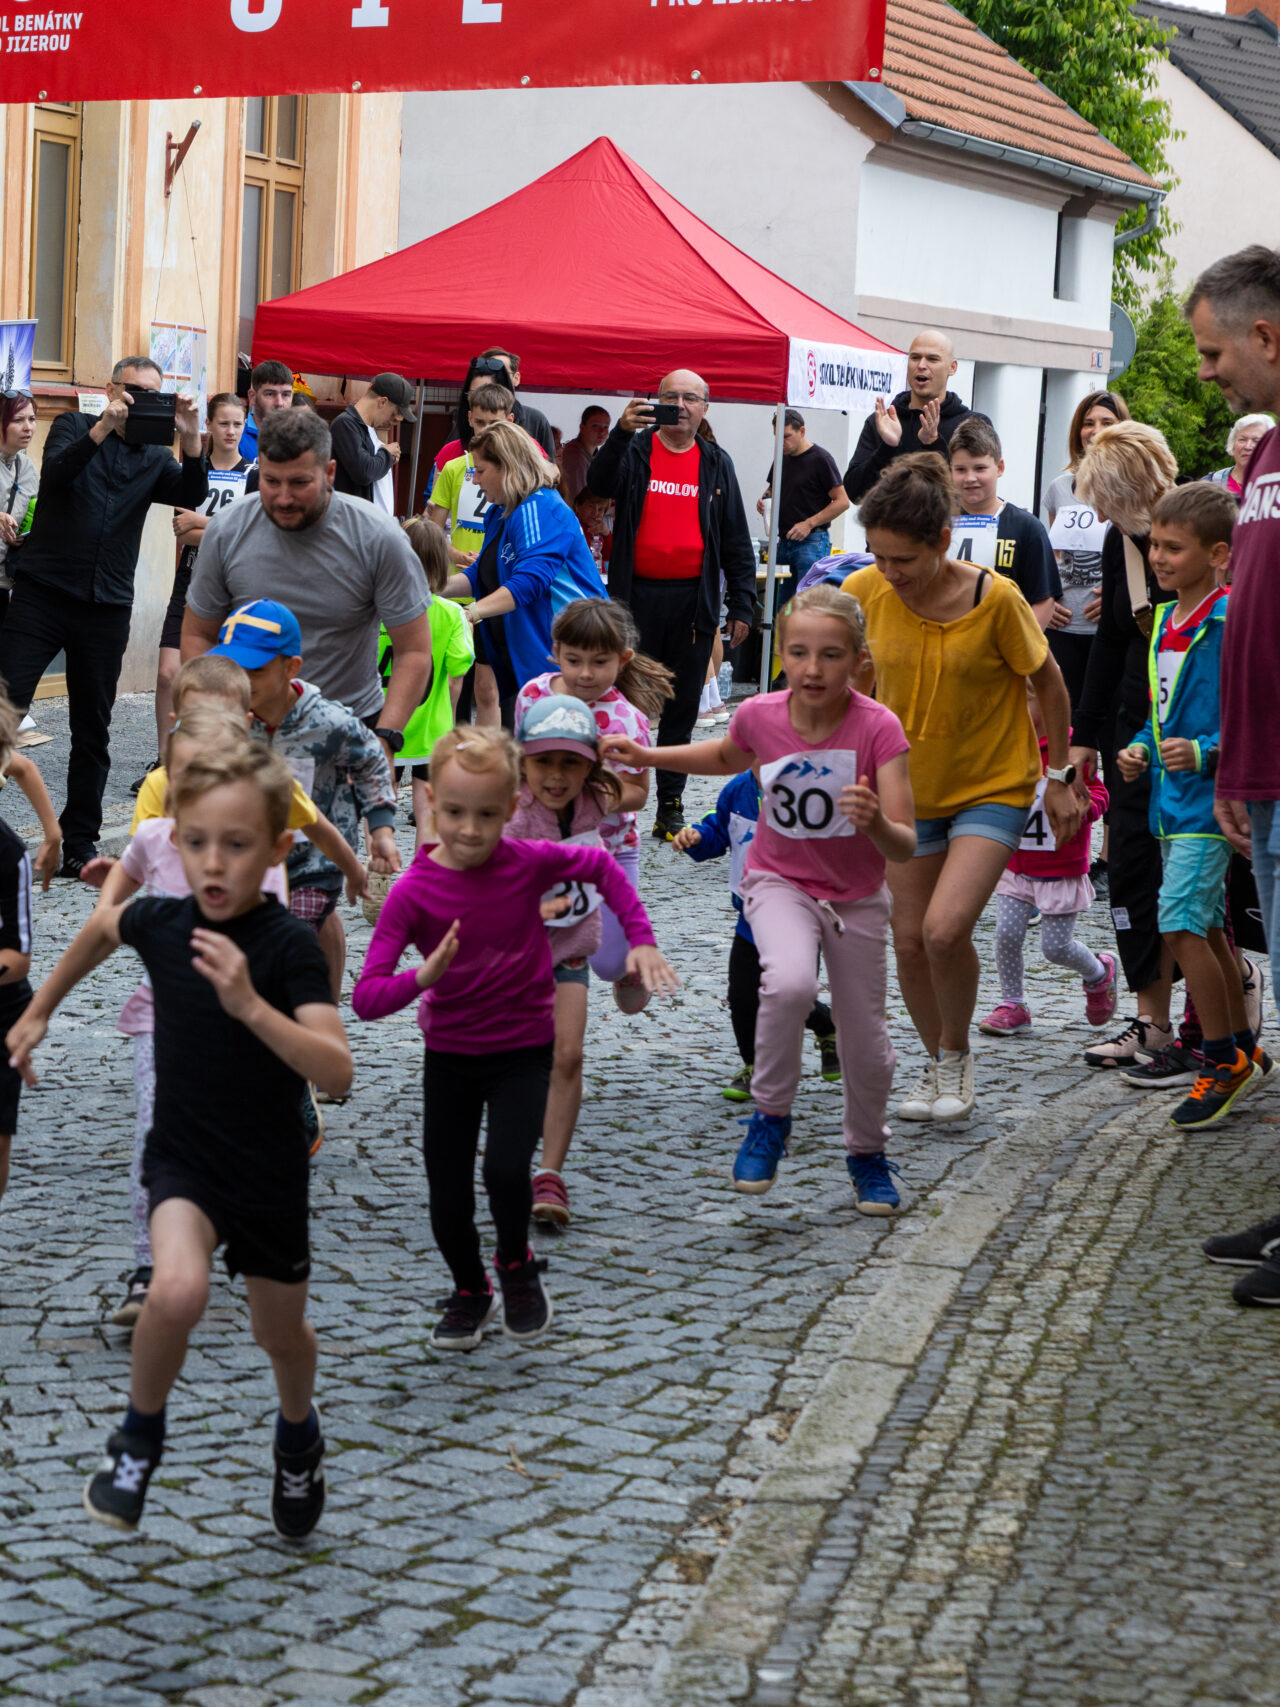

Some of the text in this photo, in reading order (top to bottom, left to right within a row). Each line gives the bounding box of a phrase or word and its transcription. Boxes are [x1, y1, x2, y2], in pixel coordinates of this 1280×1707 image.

[14, 10, 83, 32] BENÁTKY
[5, 34, 71, 53] JIZEROU
[1063, 510, 1095, 530] 30
[771, 783, 834, 830] 30
